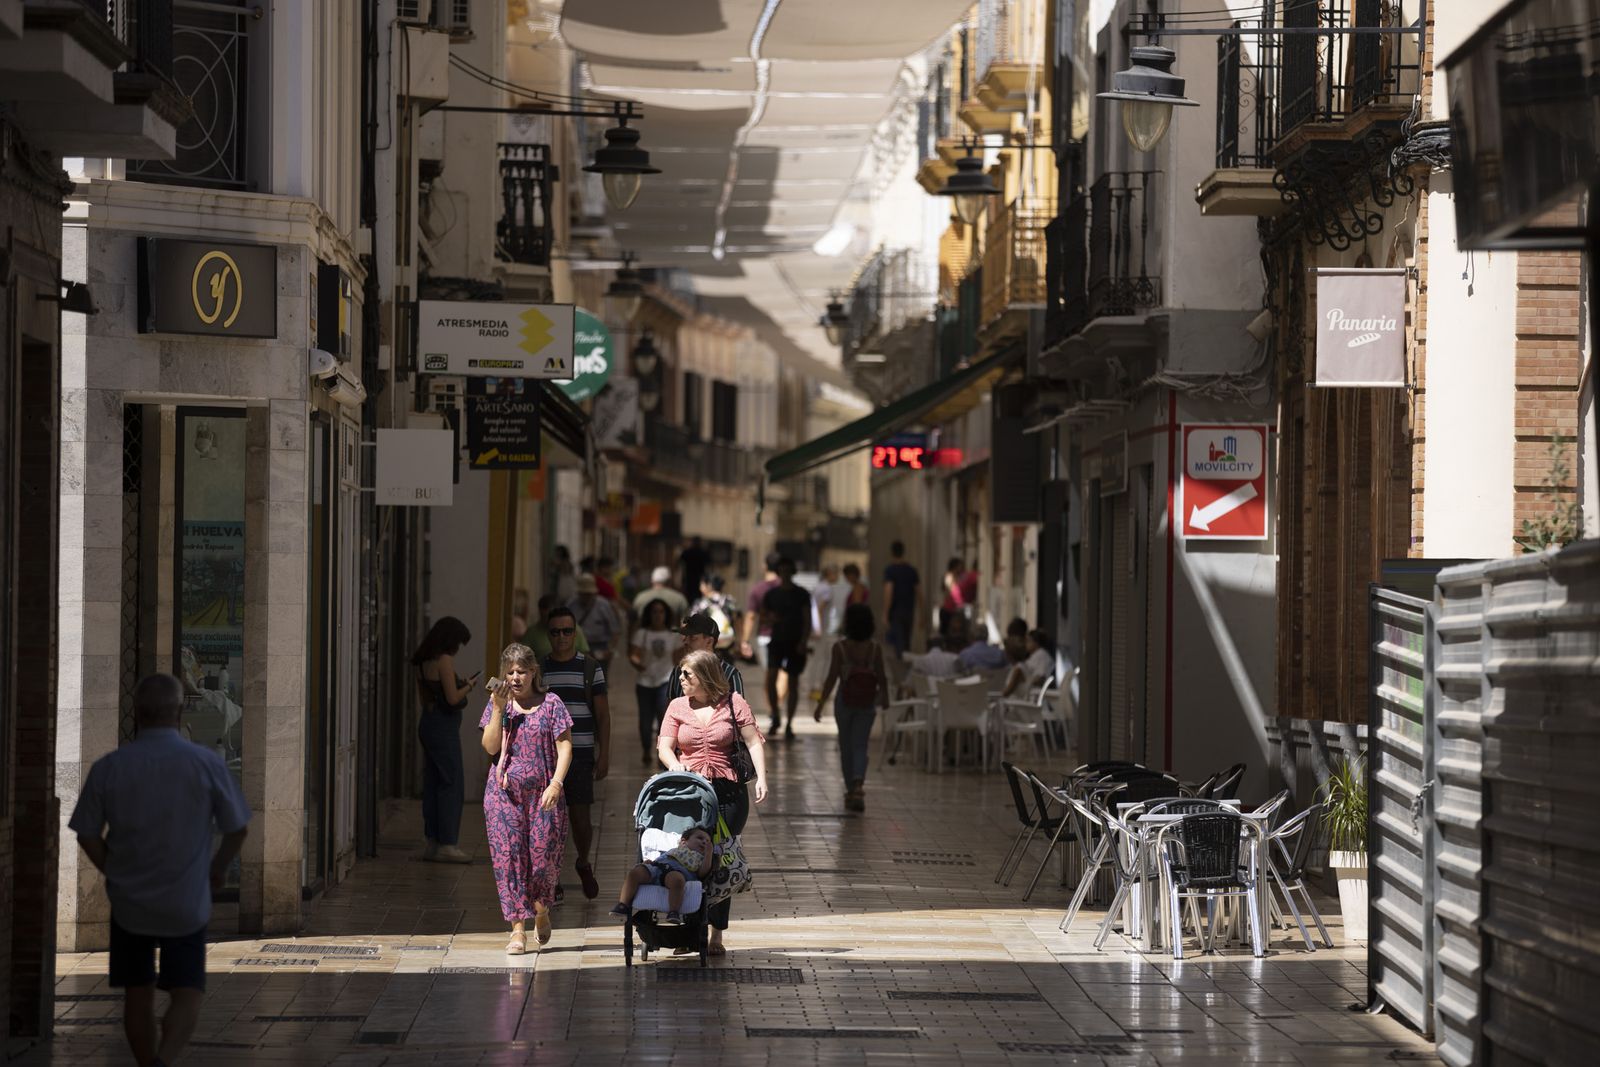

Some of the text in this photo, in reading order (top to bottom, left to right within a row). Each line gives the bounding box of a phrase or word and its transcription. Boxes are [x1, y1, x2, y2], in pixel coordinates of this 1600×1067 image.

[437, 318, 509, 329] ATRESMEDIA
[1326, 308, 1397, 331] Panaria
[478, 329, 509, 337] RADIO
[1195, 462, 1254, 472] MOVILCITY
[192, 526, 243, 537] HUELVA
